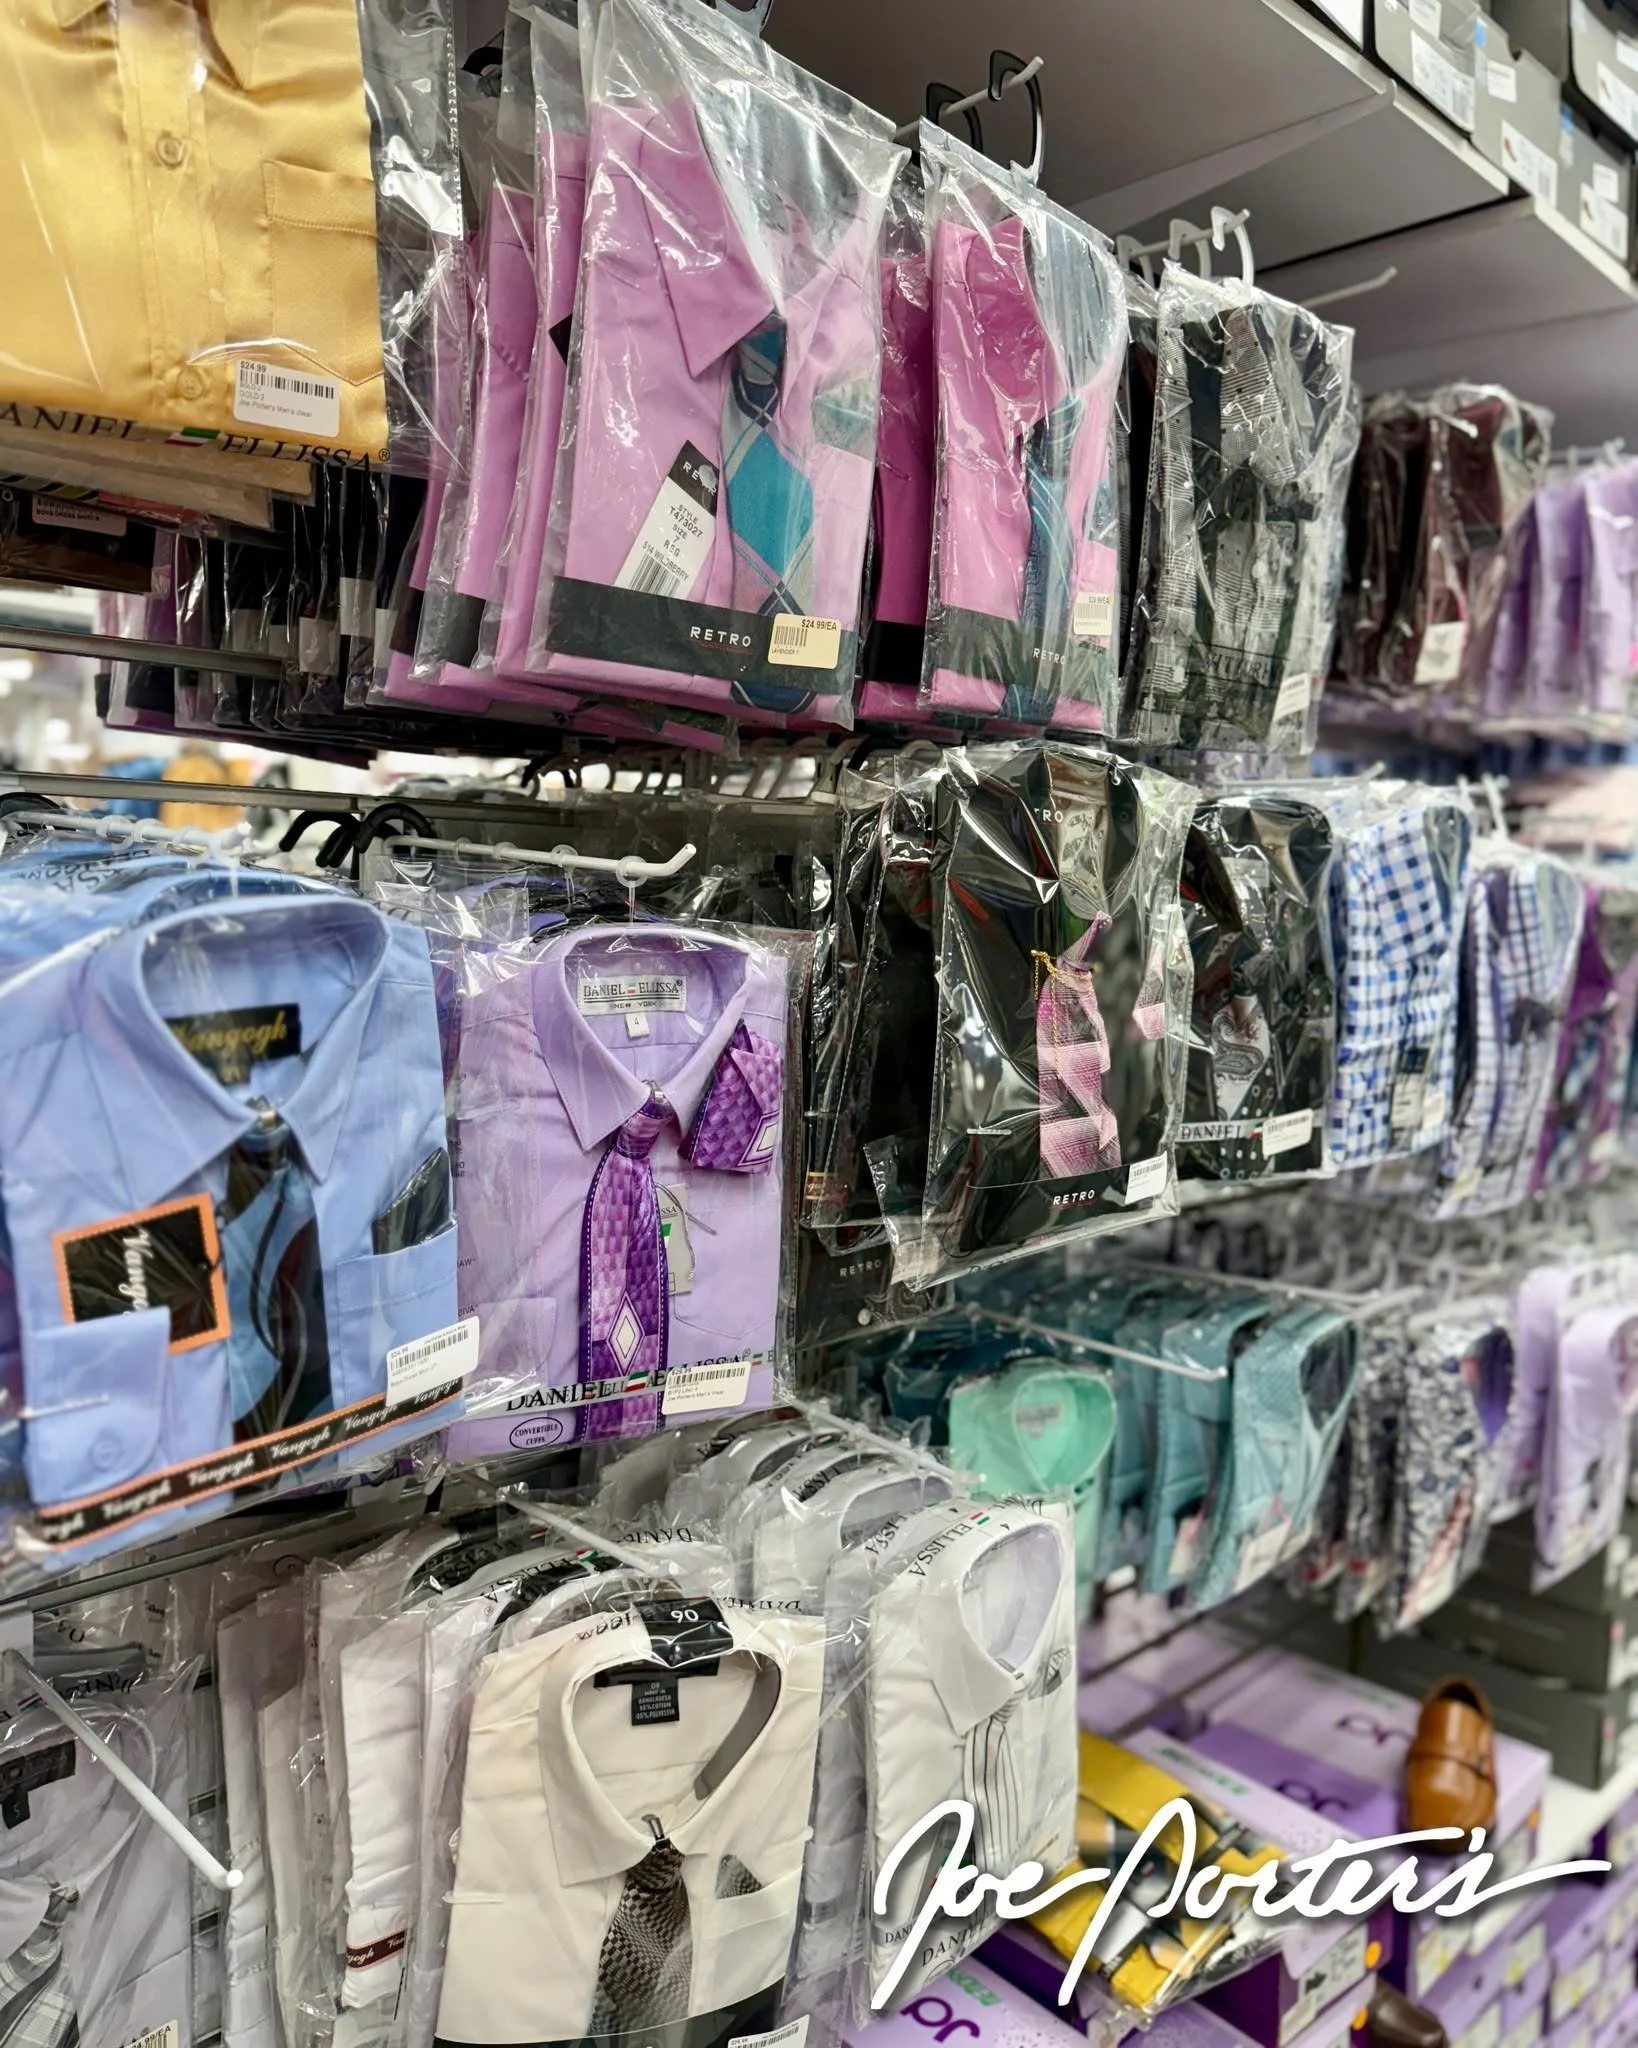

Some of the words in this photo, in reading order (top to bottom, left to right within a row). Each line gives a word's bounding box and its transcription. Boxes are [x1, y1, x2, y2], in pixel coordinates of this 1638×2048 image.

[240, 360, 267, 374] $24.99
[0, 402, 148, 442] ANIEL
[221, 433, 372, 471] ELLISSA
[669, 506, 703, 538] T473027
[679, 504, 699, 525] STYLE
[672, 523, 688, 540] SIZE
[663, 539, 681, 558] REG
[801, 618, 837, 631] $24.99/EA
[690, 625, 752, 648] RETRO
[1032, 647, 1066, 665] RETRO
[583, 983, 626, 998] DANIEL
[638, 981, 679, 994] ELLISSA
[1053, 1188, 1096, 1206] RETRO
[118, 1226, 154, 1315] Vango
[839, 1259, 882, 1277] RETRO
[506, 1380, 612, 1411] DANIEL
[514, 1422, 558, 1438] CONVERTIBLE
[271, 1425, 331, 1460] Vangogh
[908, 1522, 974, 1578] ELLISSA
